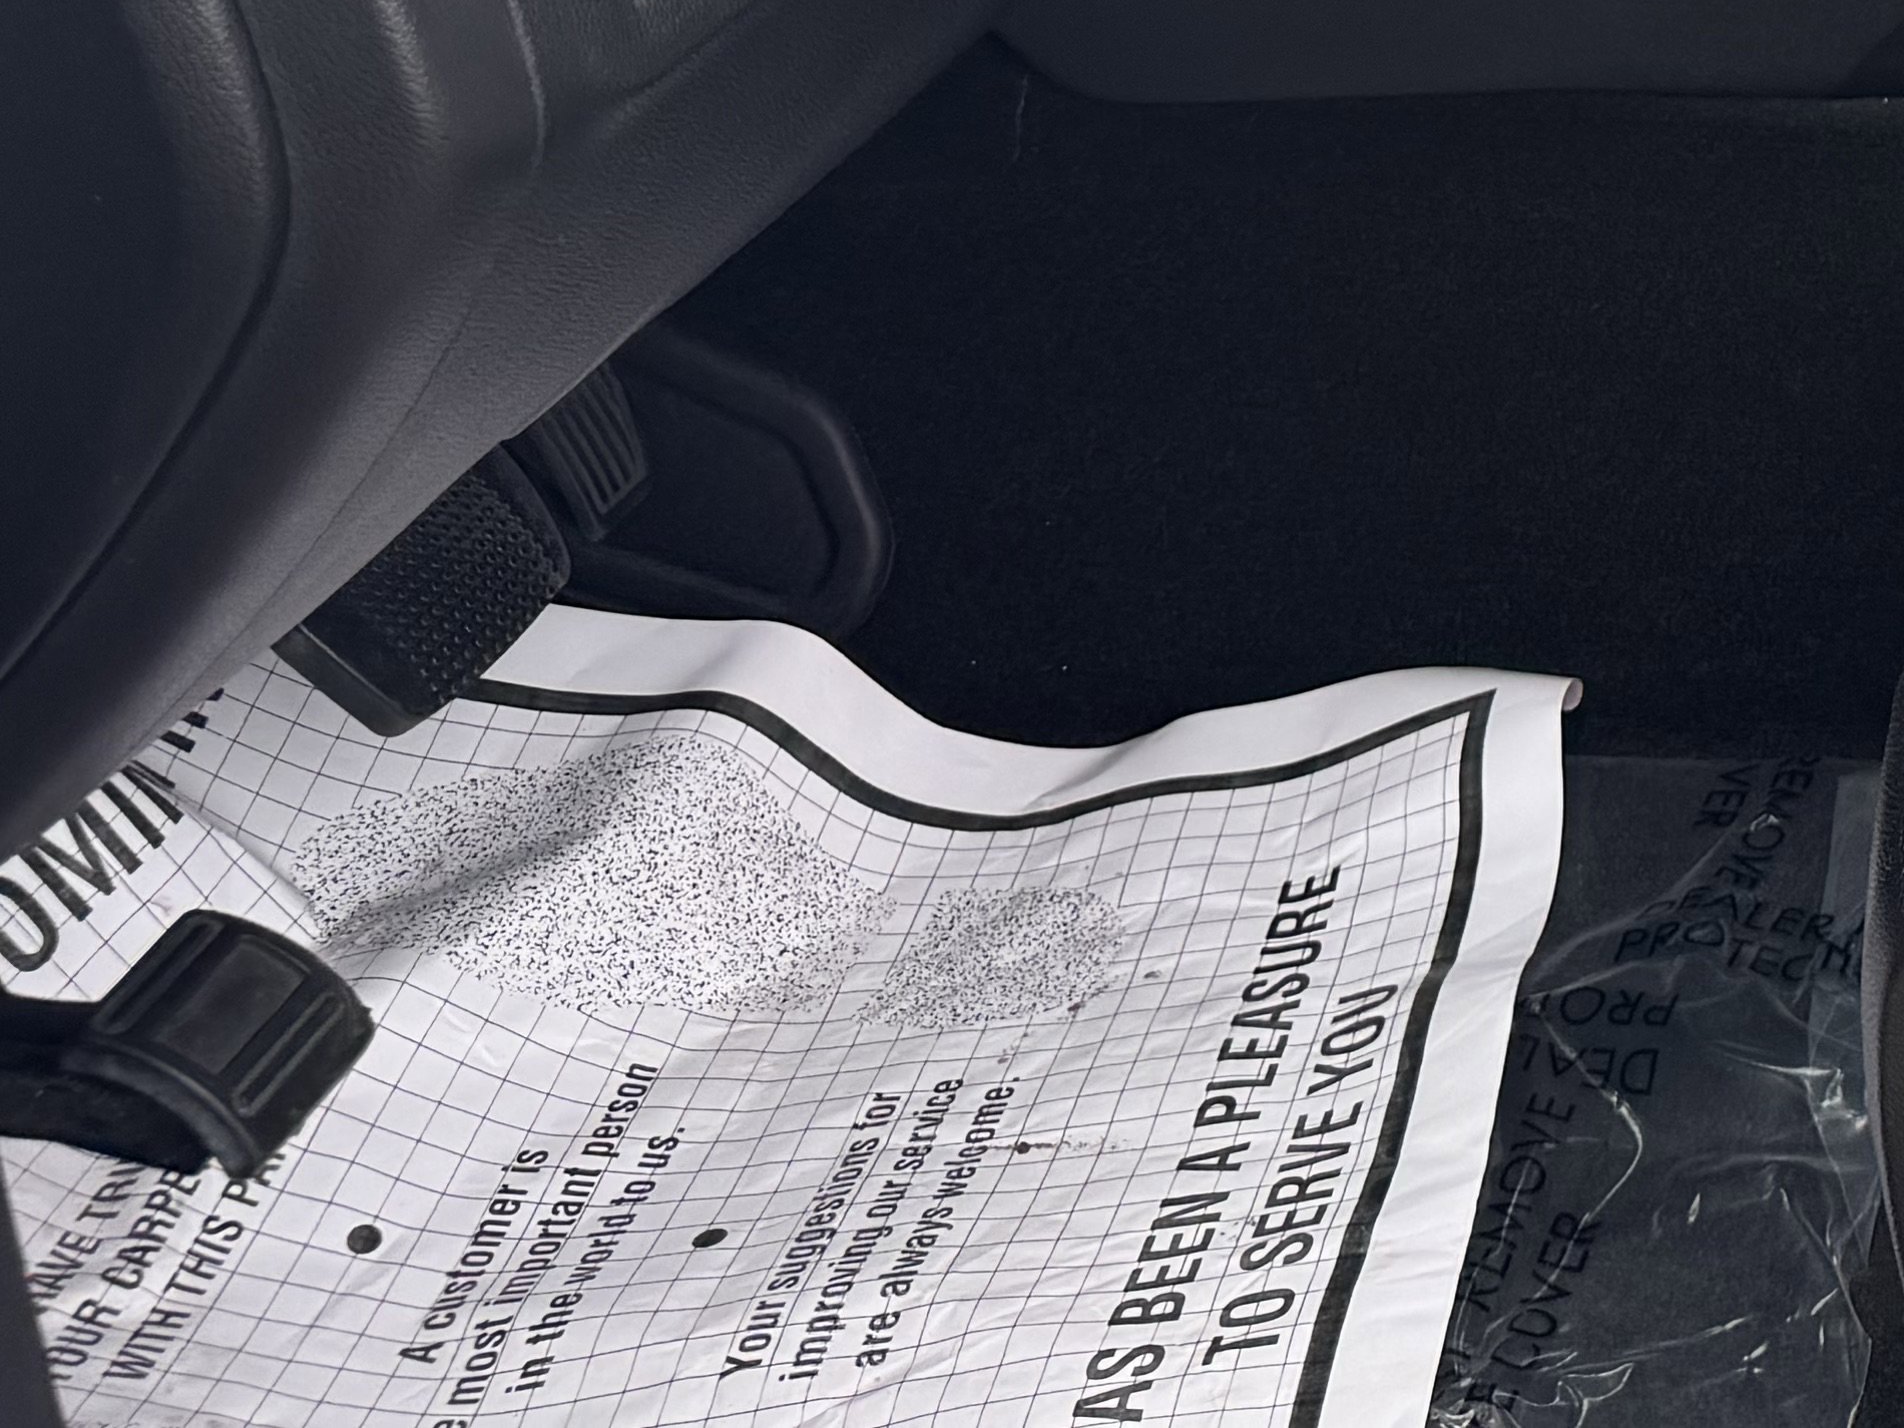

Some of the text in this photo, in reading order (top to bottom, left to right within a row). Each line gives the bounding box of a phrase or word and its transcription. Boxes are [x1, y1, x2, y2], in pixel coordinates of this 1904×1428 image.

[1072, 865, 1341, 1423] AS BEEN A PLEASURE
[1202, 983, 1399, 1366] TO SERVE YOU
[1523, 1034, 1659, 1096] DEAL
[102, 1169, 202, 1290] CARPE
[103, 1307, 191, 1380] WITH
[164, 1215, 244, 1296] THIS
[398, 1149, 549, 1364] A customer is
[447, 1315, 514, 1405] most
[484, 1166, 602, 1307] important
[581, 1063, 658, 1158] person
[505, 1127, 686, 1393] in the world to us.
[719, 1092, 902, 1380] Your suggestions for
[779, 1078, 964, 1382] improving our service
[856, 1076, 1021, 1368] are always welcome.
